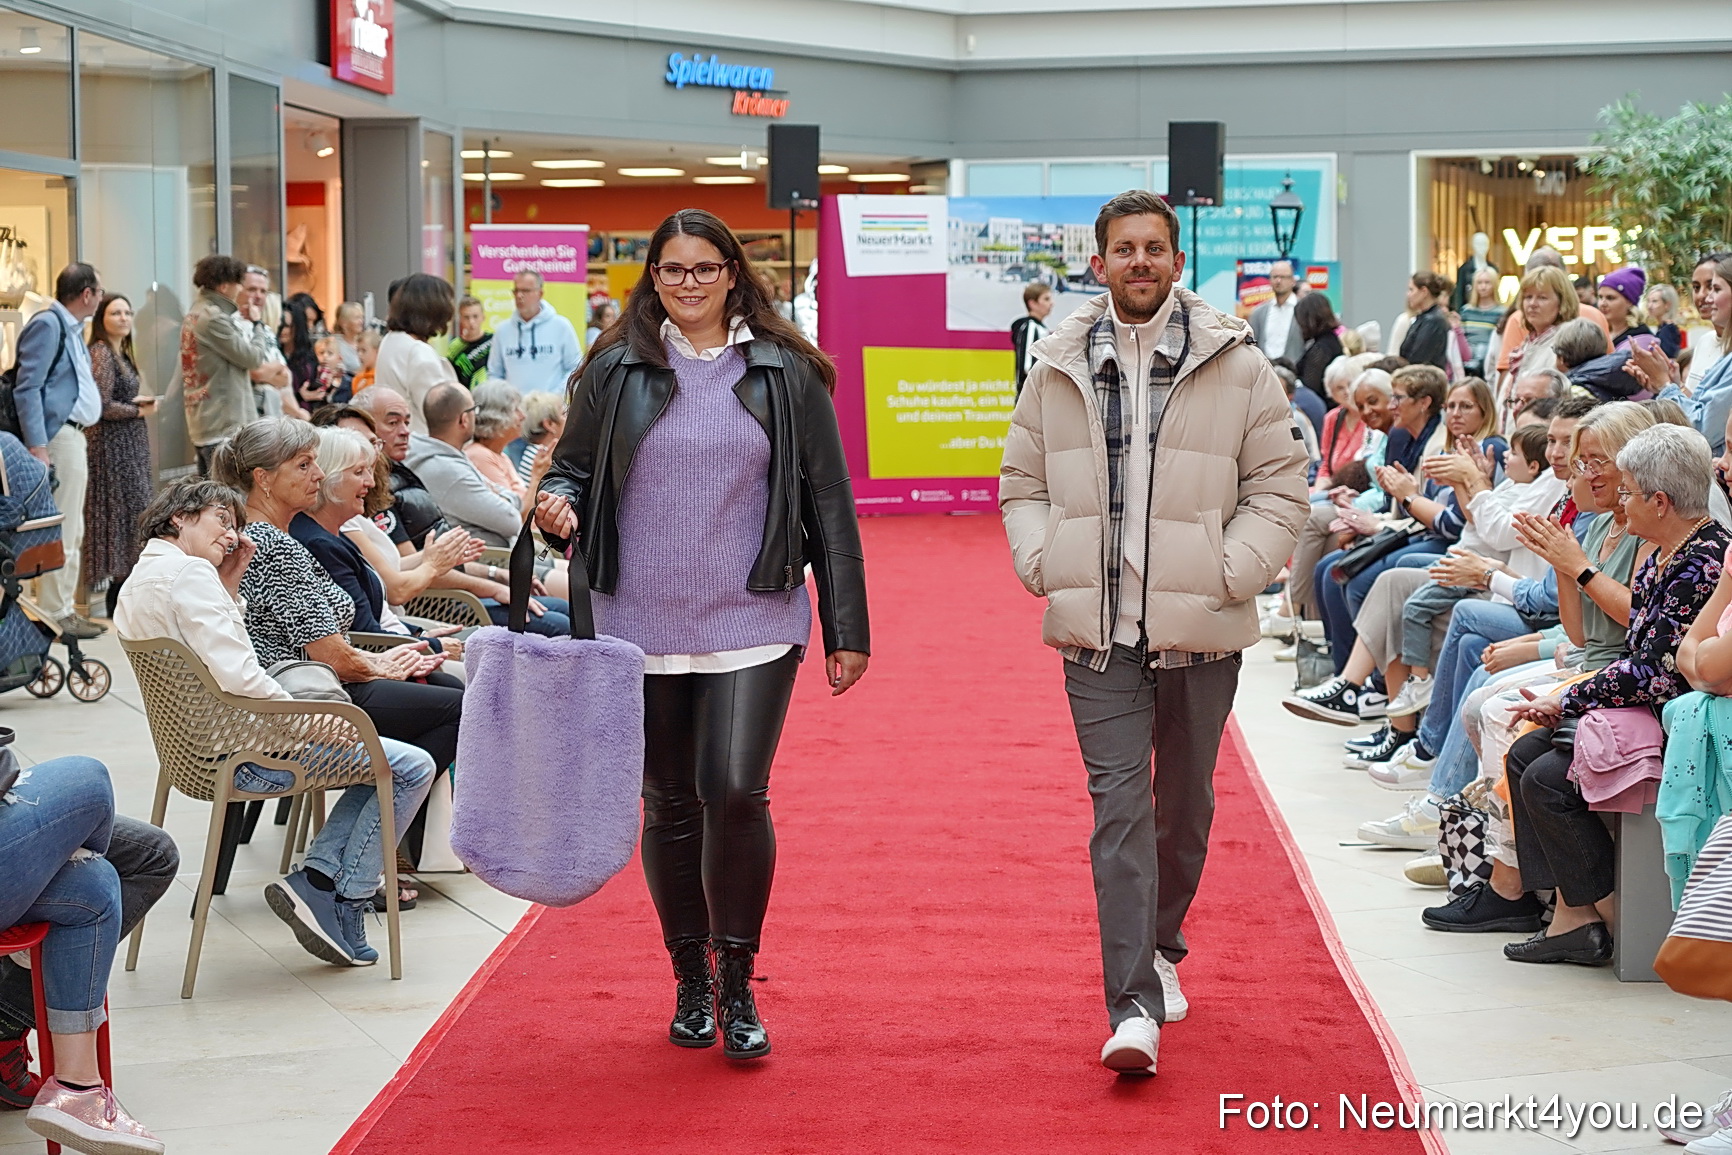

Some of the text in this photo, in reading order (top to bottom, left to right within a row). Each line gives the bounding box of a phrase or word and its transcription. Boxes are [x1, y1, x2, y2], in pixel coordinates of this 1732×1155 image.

[665, 52, 774, 90] Spielwaren
[477, 244, 577, 259] Verschenken Sie
[1502, 225, 1644, 266] VER
[503, 258, 577, 273] Gutscheine!
[897, 379, 915, 392] Du
[915, 379, 965, 392] würdest
[965, 380, 978, 394] ja
[978, 379, 1009, 392] nicht
[886, 394, 930, 407] Schuhe
[978, 394, 998, 406] ein
[896, 410, 919, 423] und
[920, 409, 962, 423] deinen
[978, 436, 995, 448] Du
